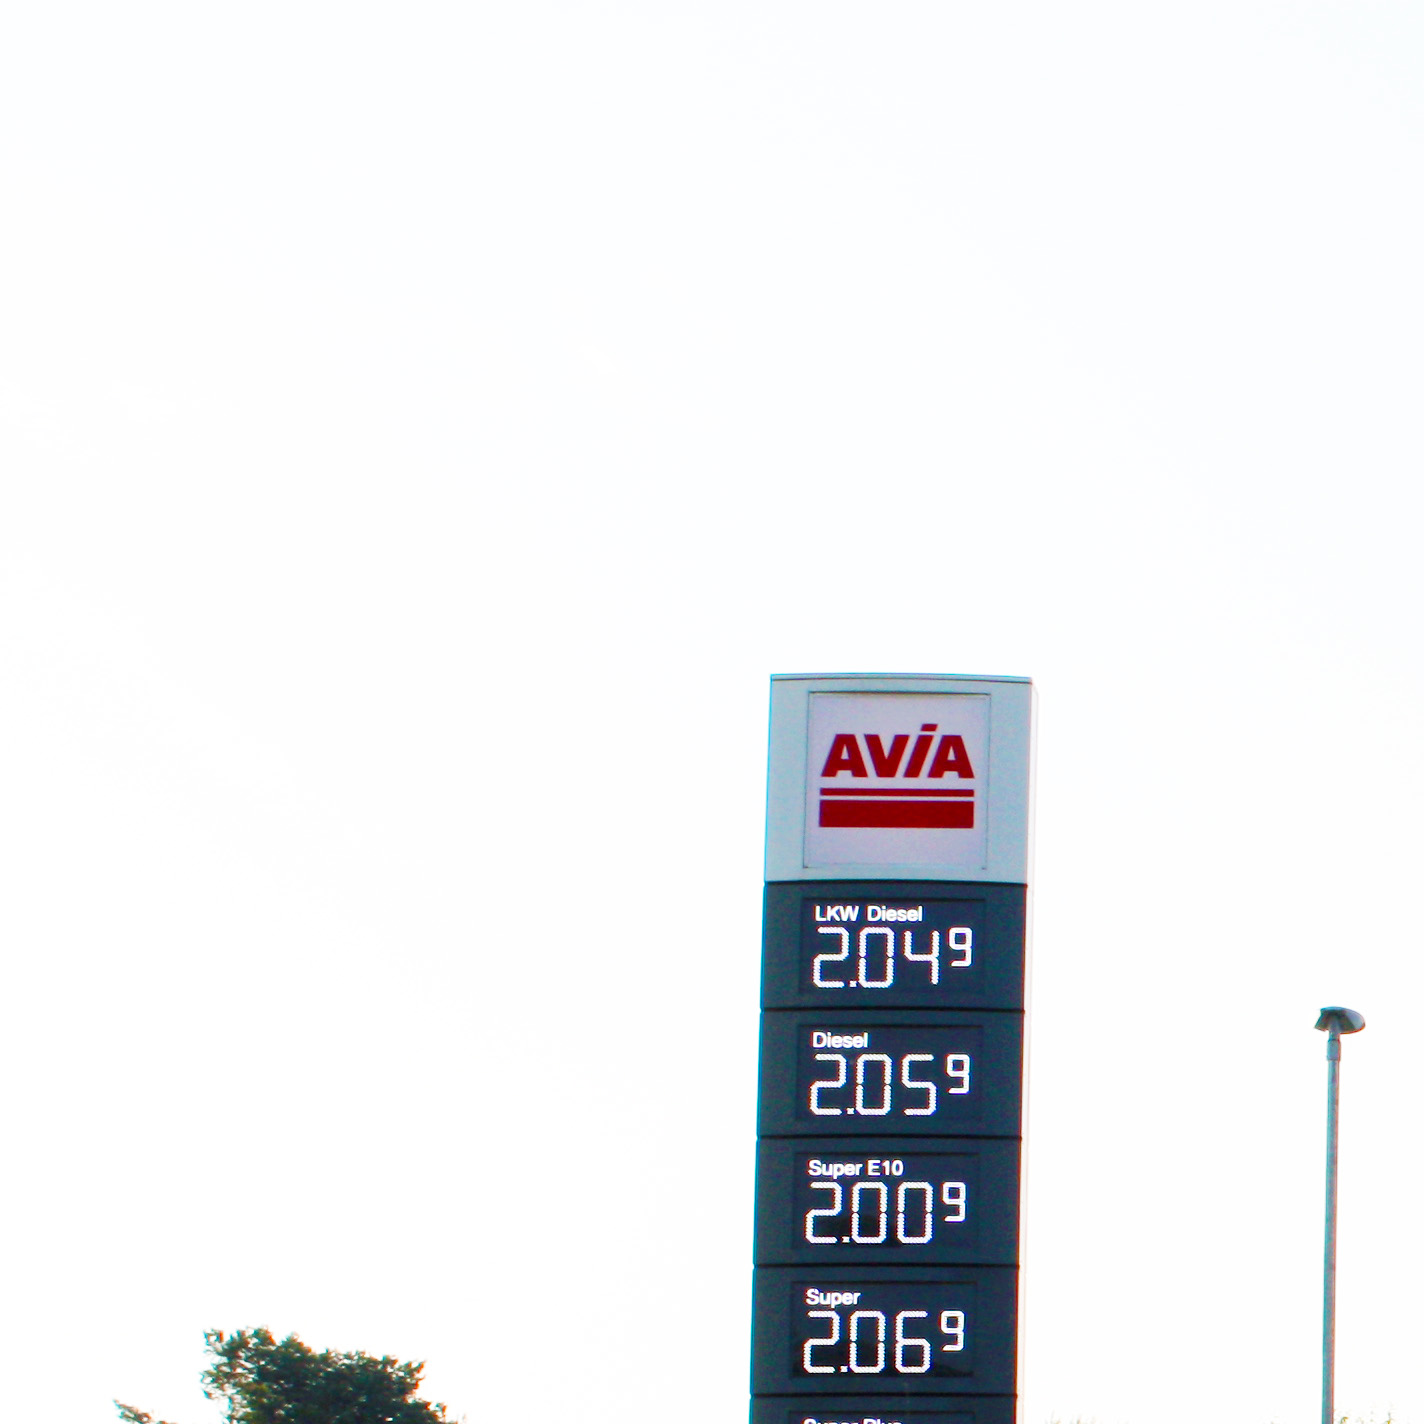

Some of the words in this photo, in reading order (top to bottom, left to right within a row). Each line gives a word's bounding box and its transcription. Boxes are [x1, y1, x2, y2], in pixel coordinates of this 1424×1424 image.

[820, 723, 975, 778] AVIA
[815, 906, 860, 922] LKW
[867, 905, 923, 922] Diesel
[811, 926, 973, 989] 2.049
[812, 1032, 868, 1048] Diesel
[809, 1053, 971, 1116] 2.059
[808, 1159, 863, 1179] Super
[868, 1159, 904, 1176] E10
[805, 1181, 967, 1244] 2.009
[806, 1288, 861, 1309] Super
[803, 1310, 965, 1373] 2.069
